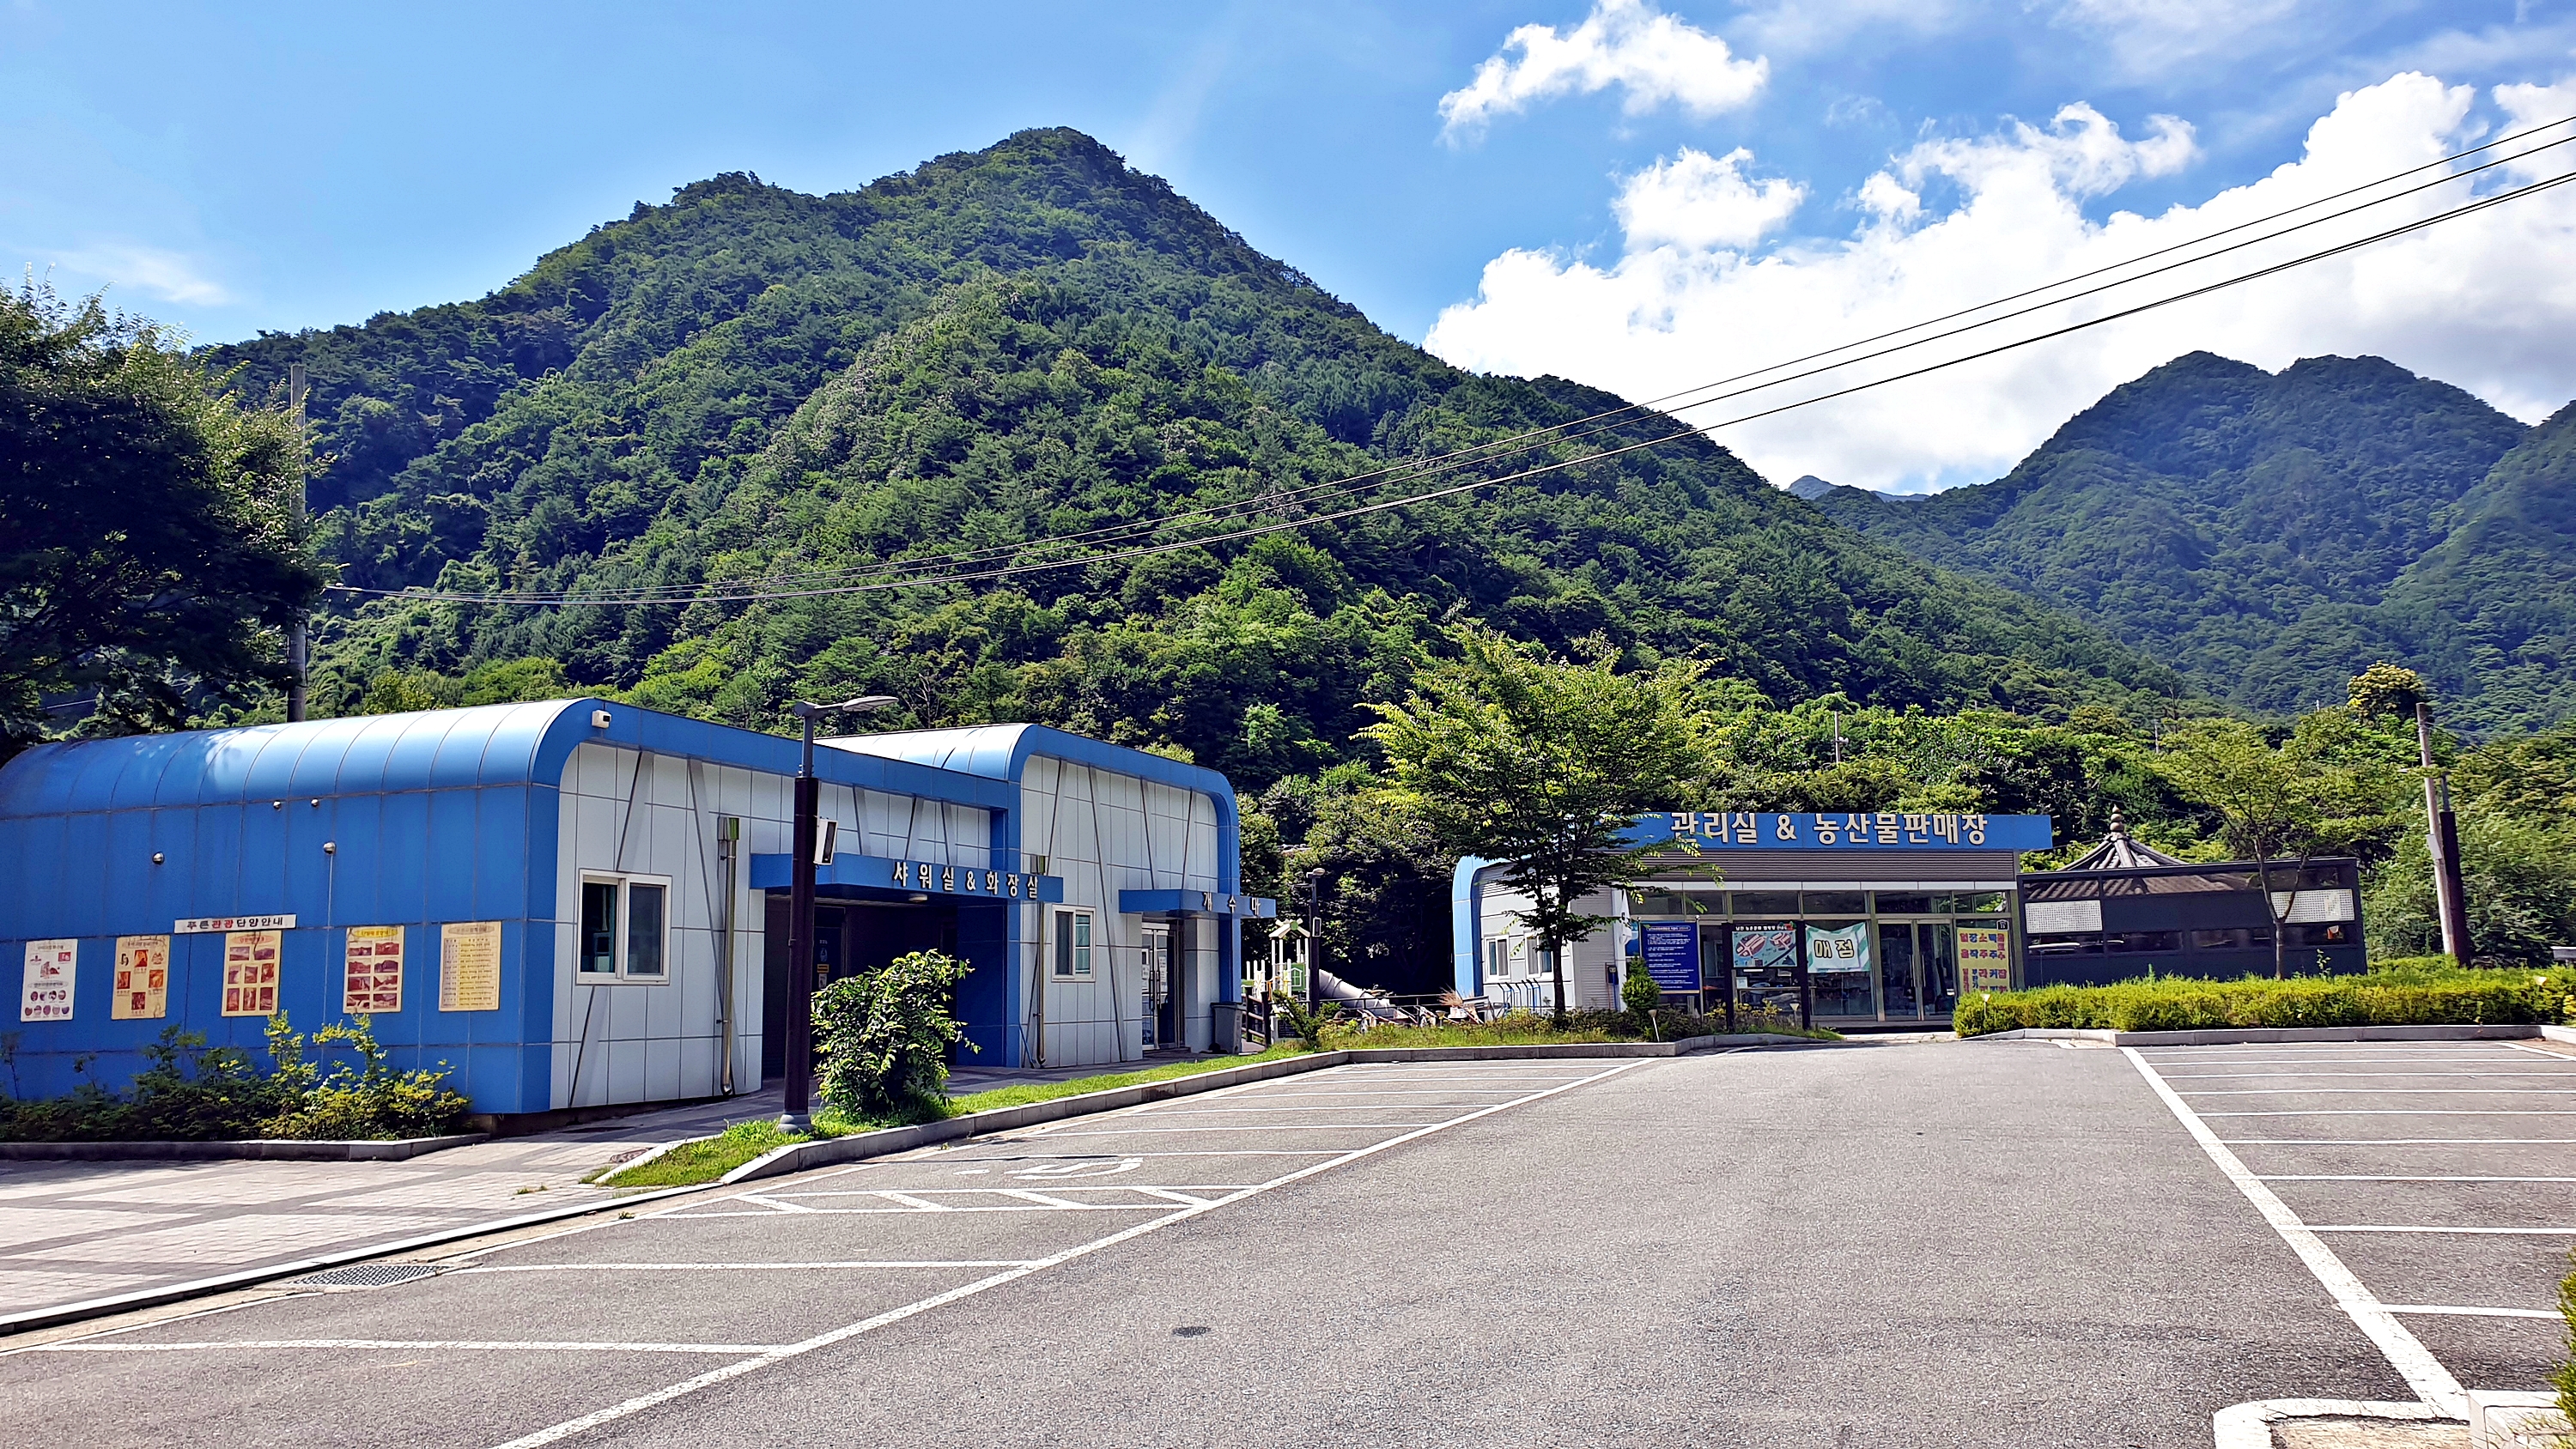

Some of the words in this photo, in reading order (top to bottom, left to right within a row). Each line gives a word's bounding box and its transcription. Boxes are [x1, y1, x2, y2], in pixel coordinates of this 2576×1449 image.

[1671, 812, 1757, 844] 관리실
[1776, 814, 1797, 840] &
[1813, 813, 1988, 845] 농산물판매장
[1814, 938, 1855, 959] 매점
